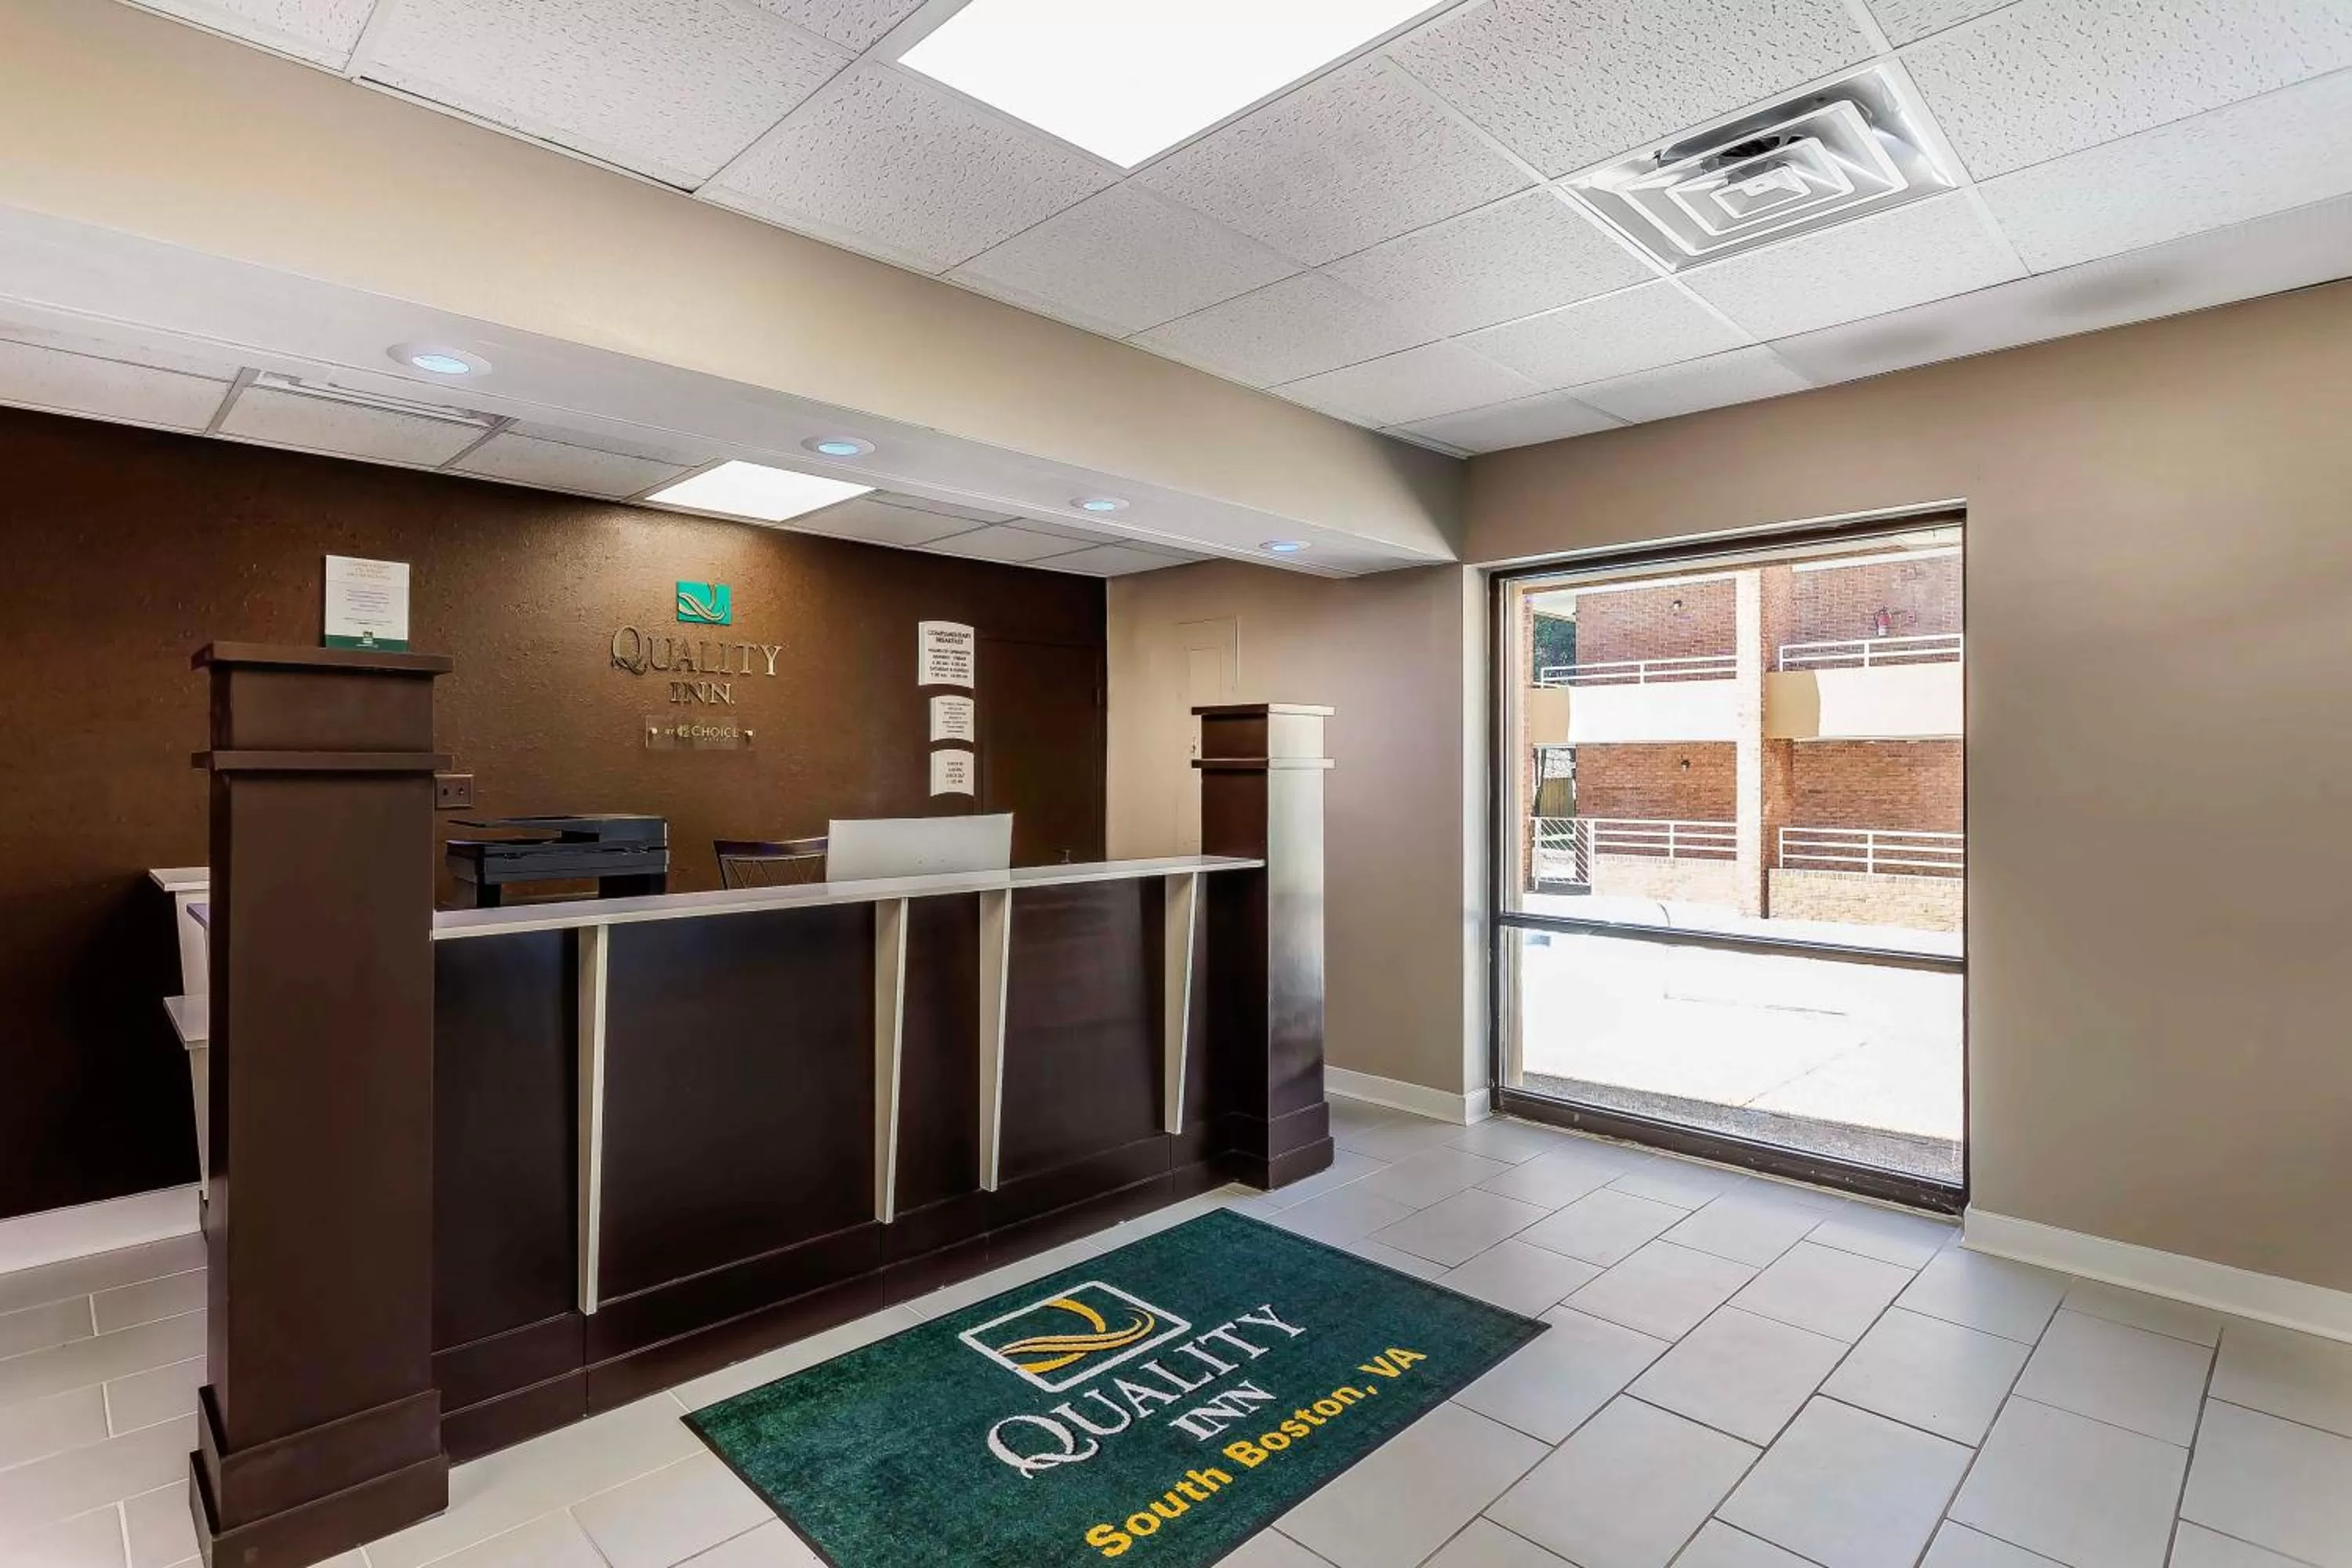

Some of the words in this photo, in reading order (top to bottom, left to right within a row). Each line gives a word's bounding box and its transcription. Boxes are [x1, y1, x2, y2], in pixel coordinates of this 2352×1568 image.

[612, 626, 783, 677] QUALITY
[669, 681, 731, 704] INN
[986, 1303, 1307, 1479] QUALITY
[1168, 1379, 1276, 1443] INN
[1084, 1464, 1234, 1558] South
[1222, 1385, 1378, 1469] Boston,
[1357, 1345, 1428, 1380] VA
